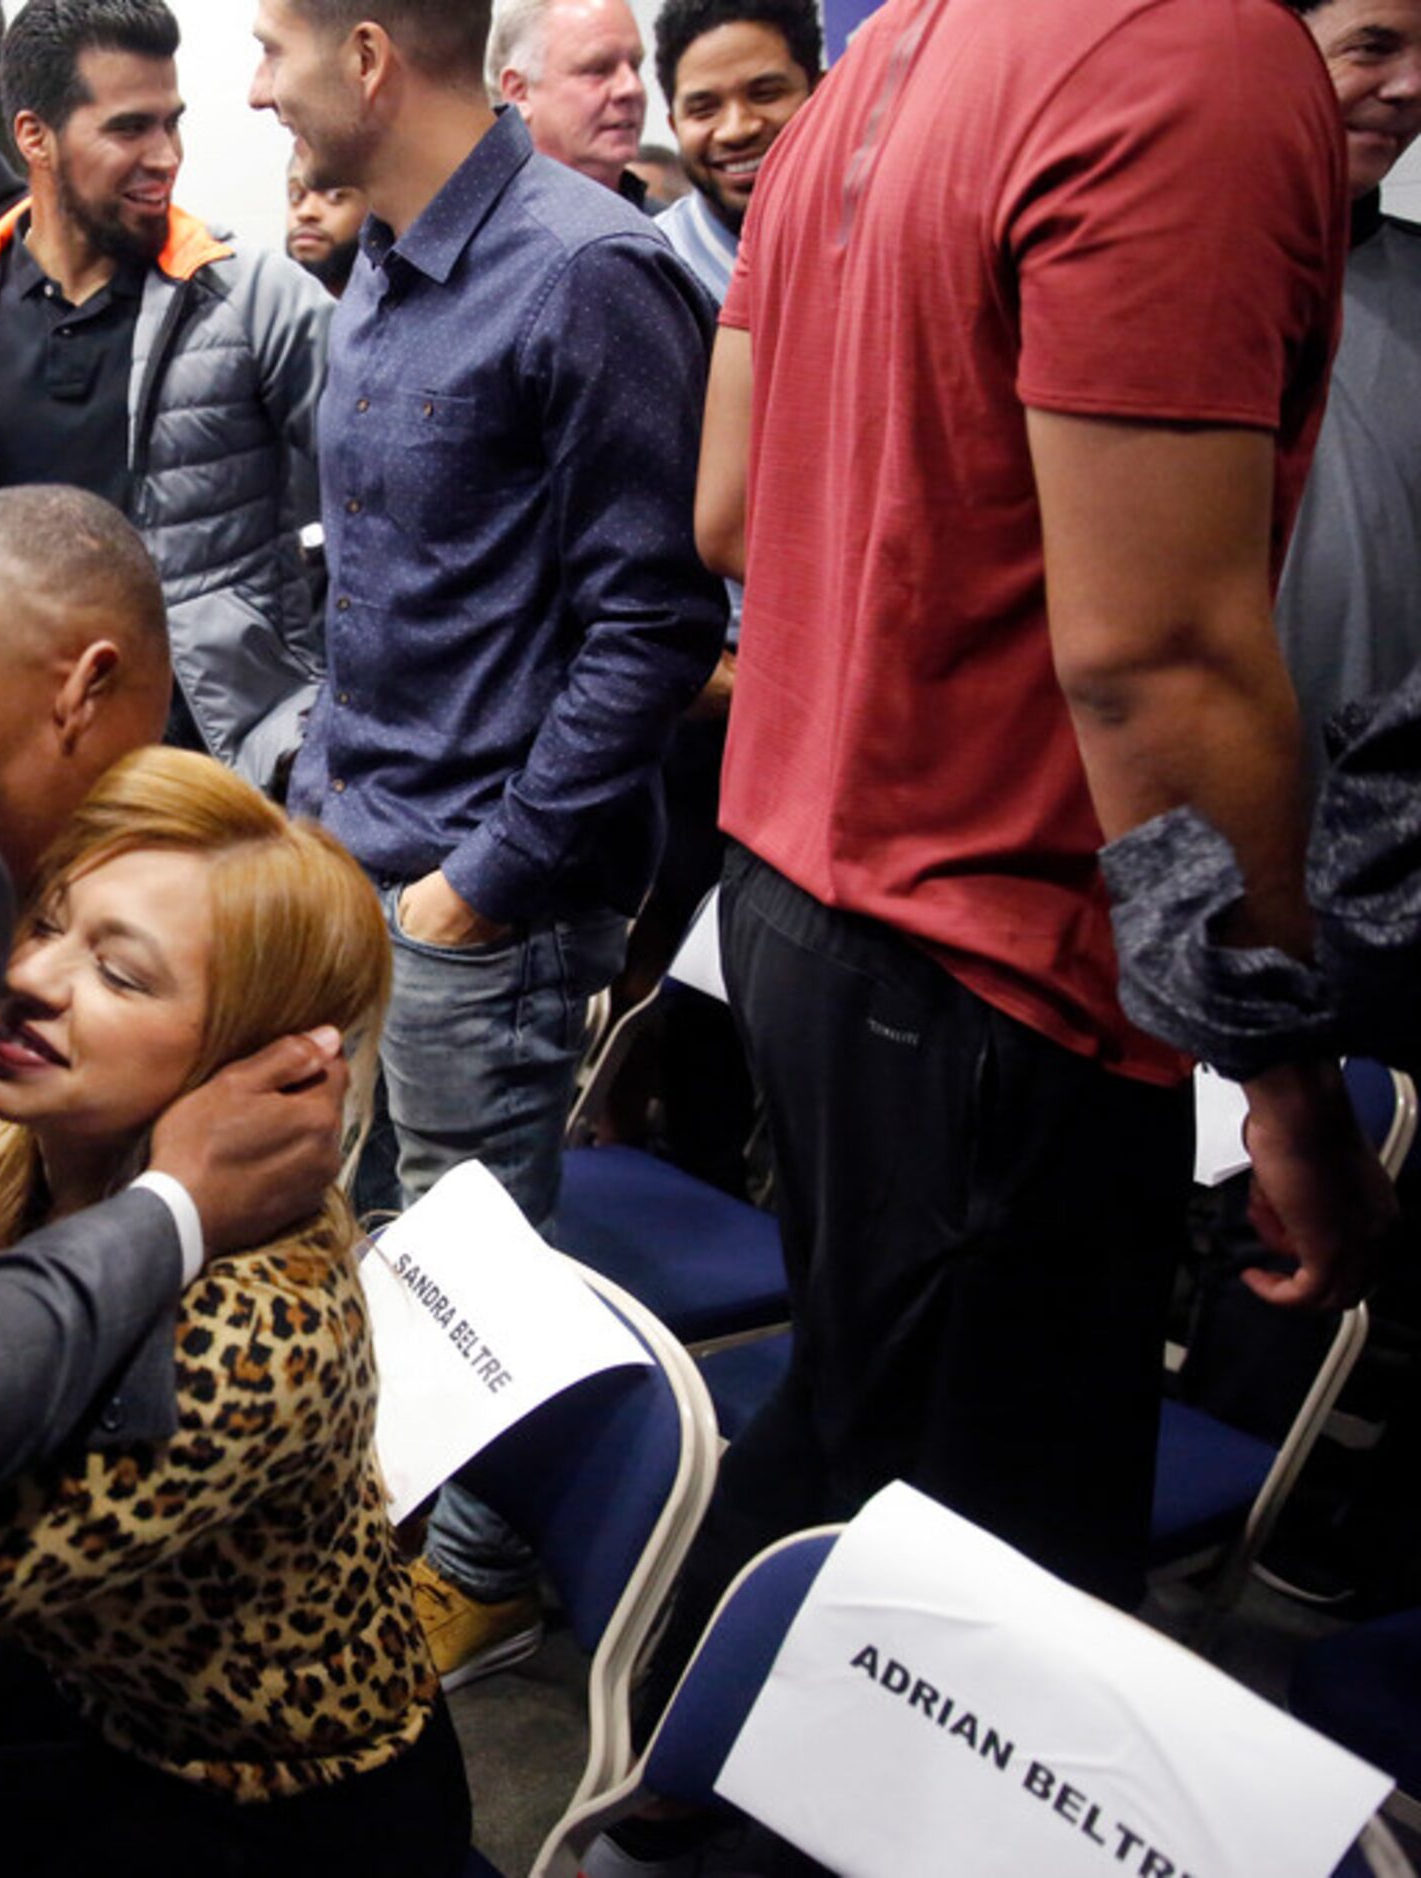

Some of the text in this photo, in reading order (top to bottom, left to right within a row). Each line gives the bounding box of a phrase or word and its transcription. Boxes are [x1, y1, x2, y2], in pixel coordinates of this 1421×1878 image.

[394, 1253, 513, 1394] SANDRA BELTRE
[850, 1644, 1197, 1878] ADRIAN BELTR
